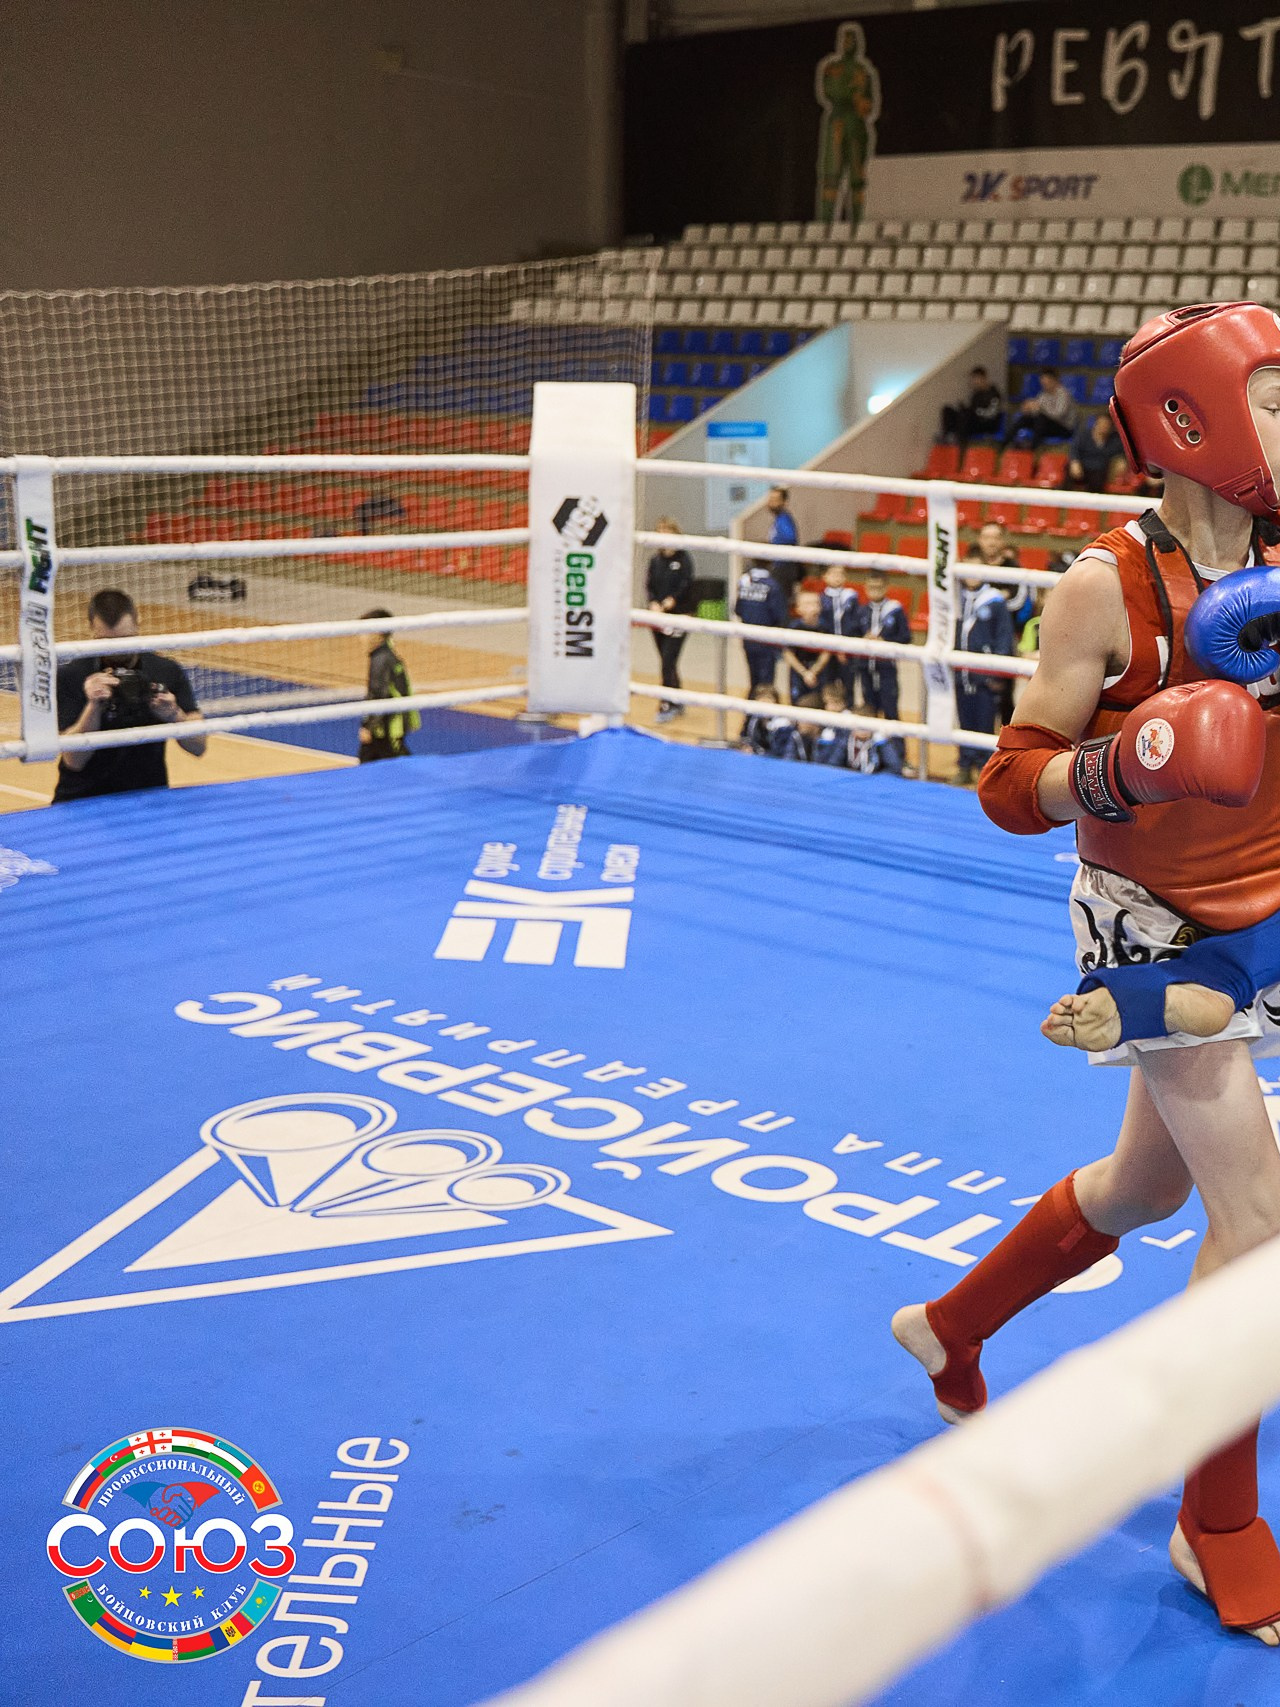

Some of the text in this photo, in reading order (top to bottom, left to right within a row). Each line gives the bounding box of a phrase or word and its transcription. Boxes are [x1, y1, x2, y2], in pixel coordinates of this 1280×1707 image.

[1009, 173, 1100, 201] SPORT
[564, 552, 595, 658] GeoSM
[268, 973, 796, 1134] ПРЕДПРИЯТИЙ
[174, 991, 1124, 1294] ТРОЙСЕРВИС
